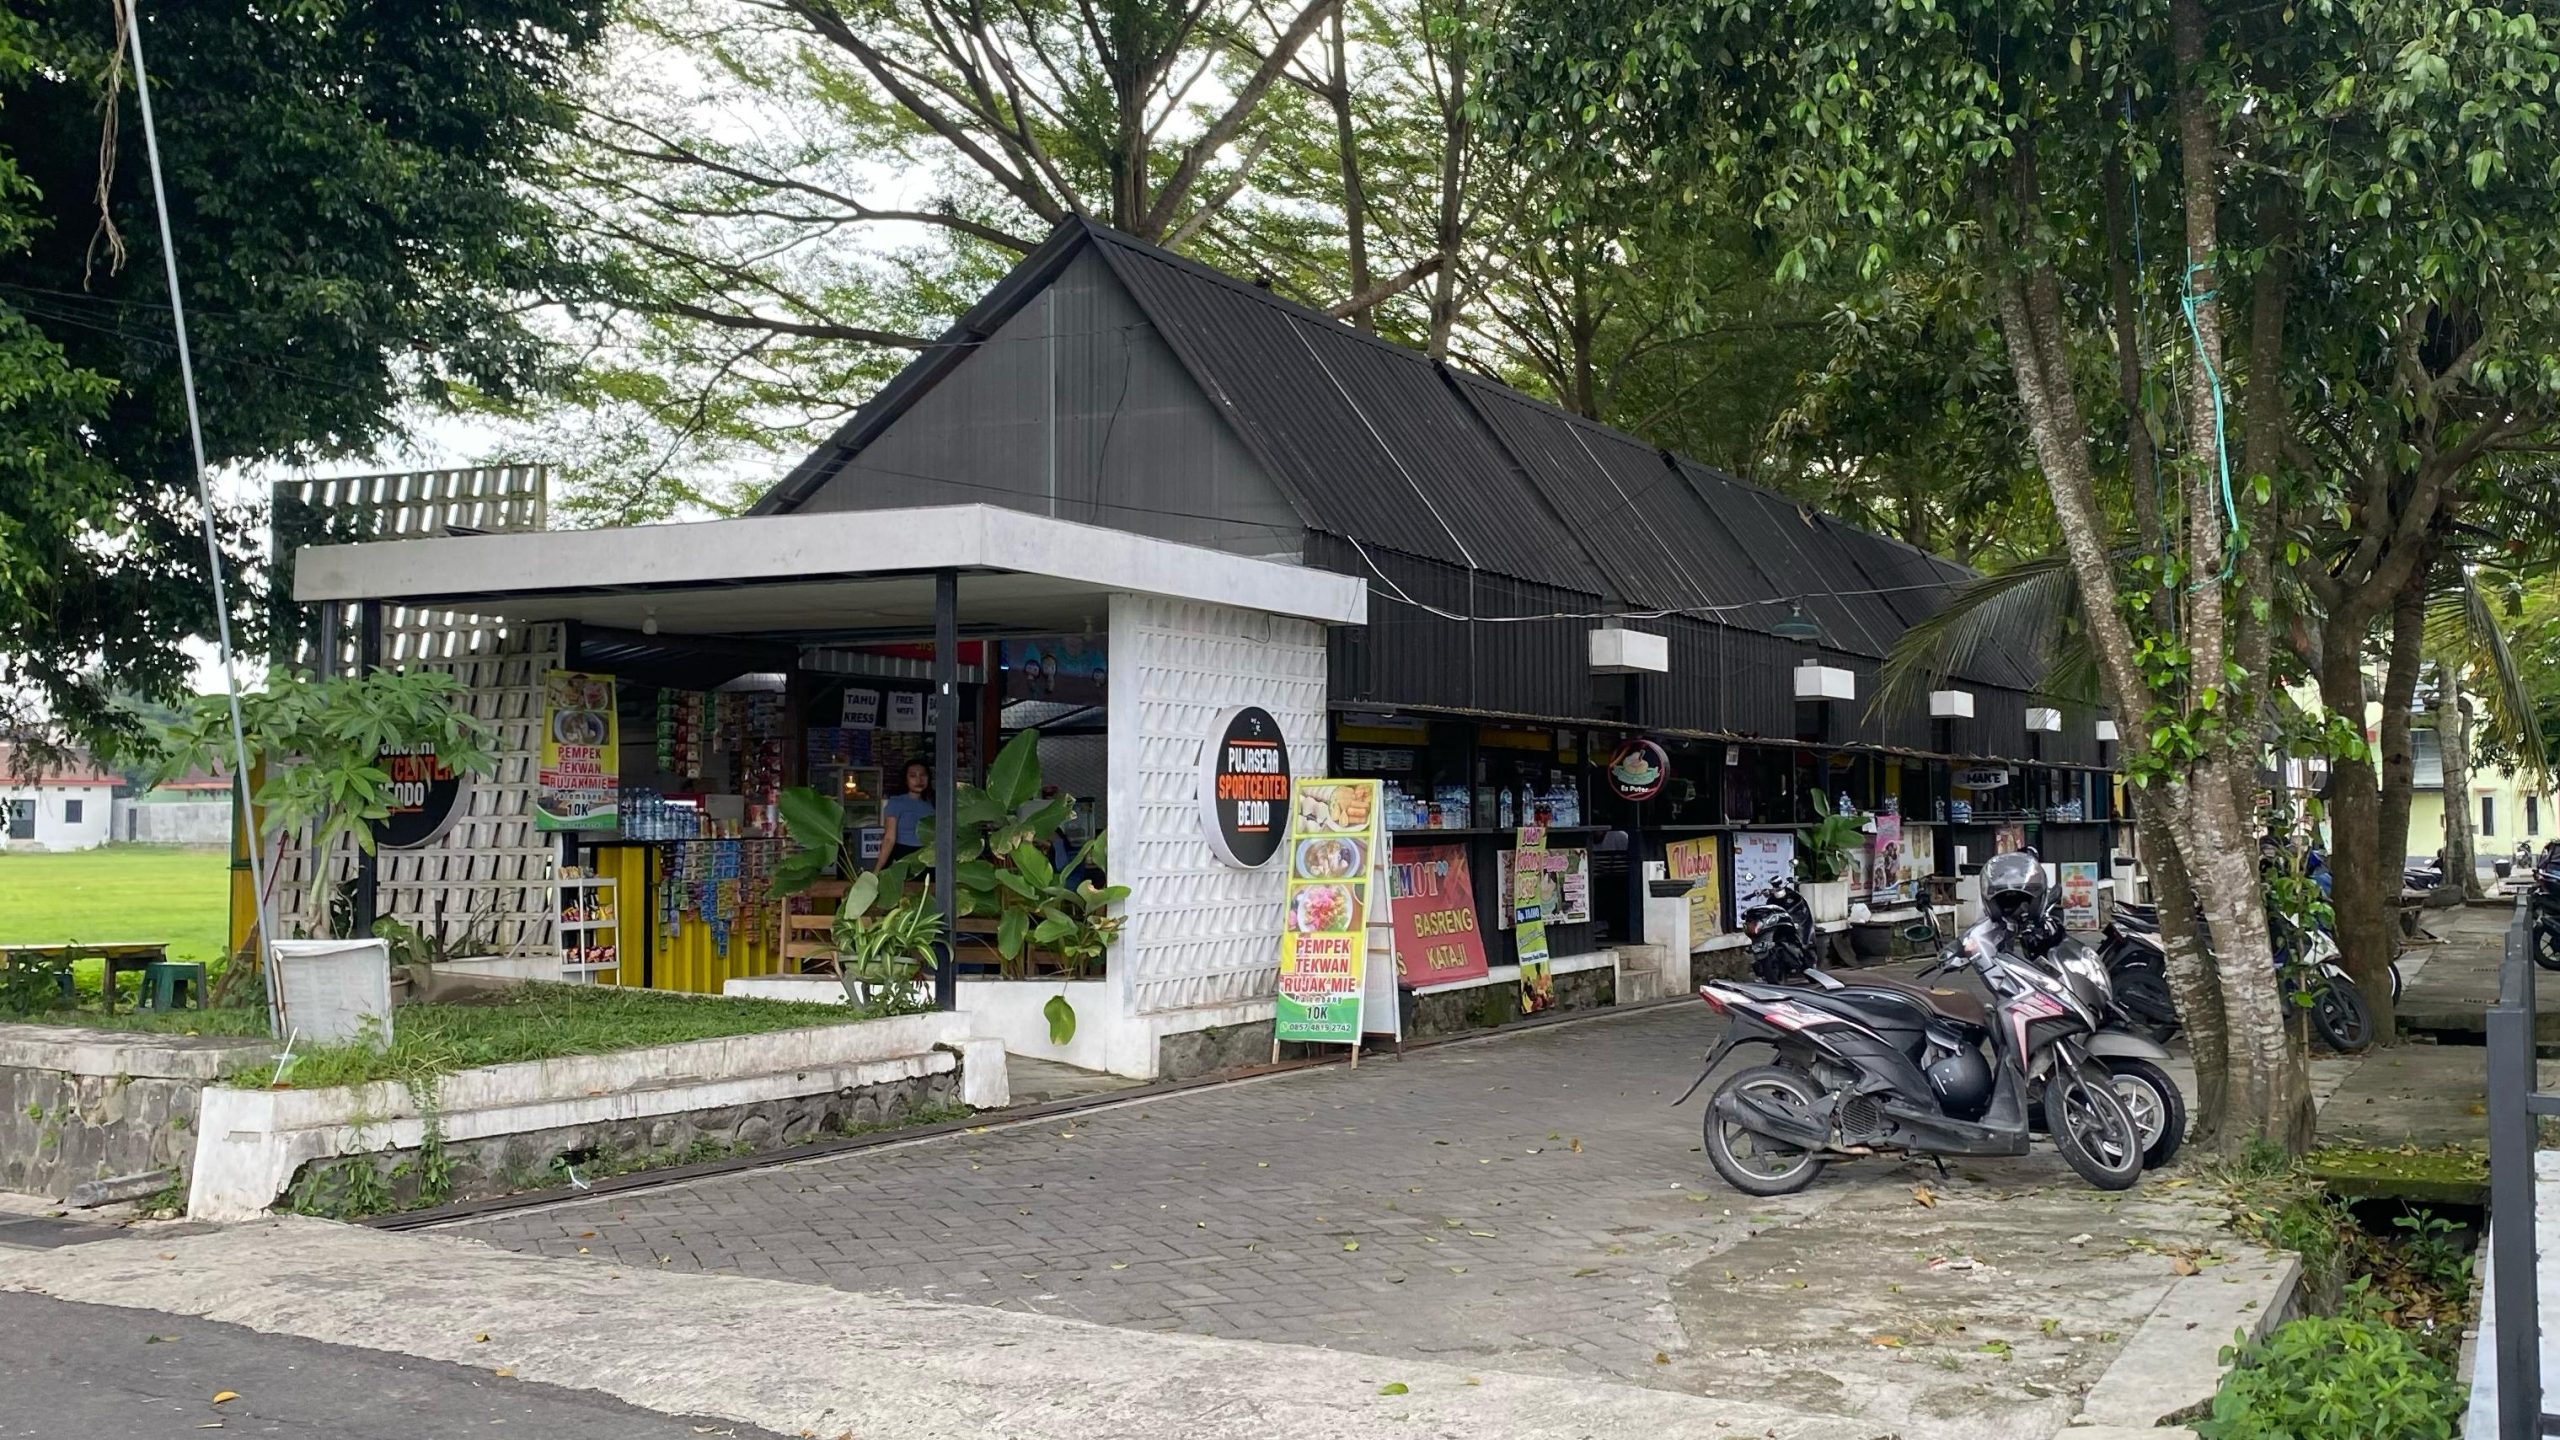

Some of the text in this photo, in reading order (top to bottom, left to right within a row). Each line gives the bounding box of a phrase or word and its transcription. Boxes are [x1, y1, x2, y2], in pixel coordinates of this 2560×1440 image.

[847, 694, 876, 705] TAHU
[895, 695, 914, 704] FREE
[844, 712, 874, 723] KRESS
[557, 746, 602, 759] PEMPEK
[1228, 747, 1279, 774] PUJASERA
[558, 762, 602, 773] TEKWAN
[550, 777, 608, 789] RUJAK MIE
[1218, 775, 1288, 800] SPORTCENTER
[567, 803, 589, 816] 10K
[1237, 801, 1270, 826] BENDO
[1414, 908, 1473, 938] BASRENG
[1296, 939, 1351, 954] PEMPEK
[1426, 943, 1468, 971] KATAJI
[1296, 959, 1349, 973] TEKWAN
[1285, 977, 1356, 993] RUJAK MIE
[1307, 1006, 1328, 1019] 10K
